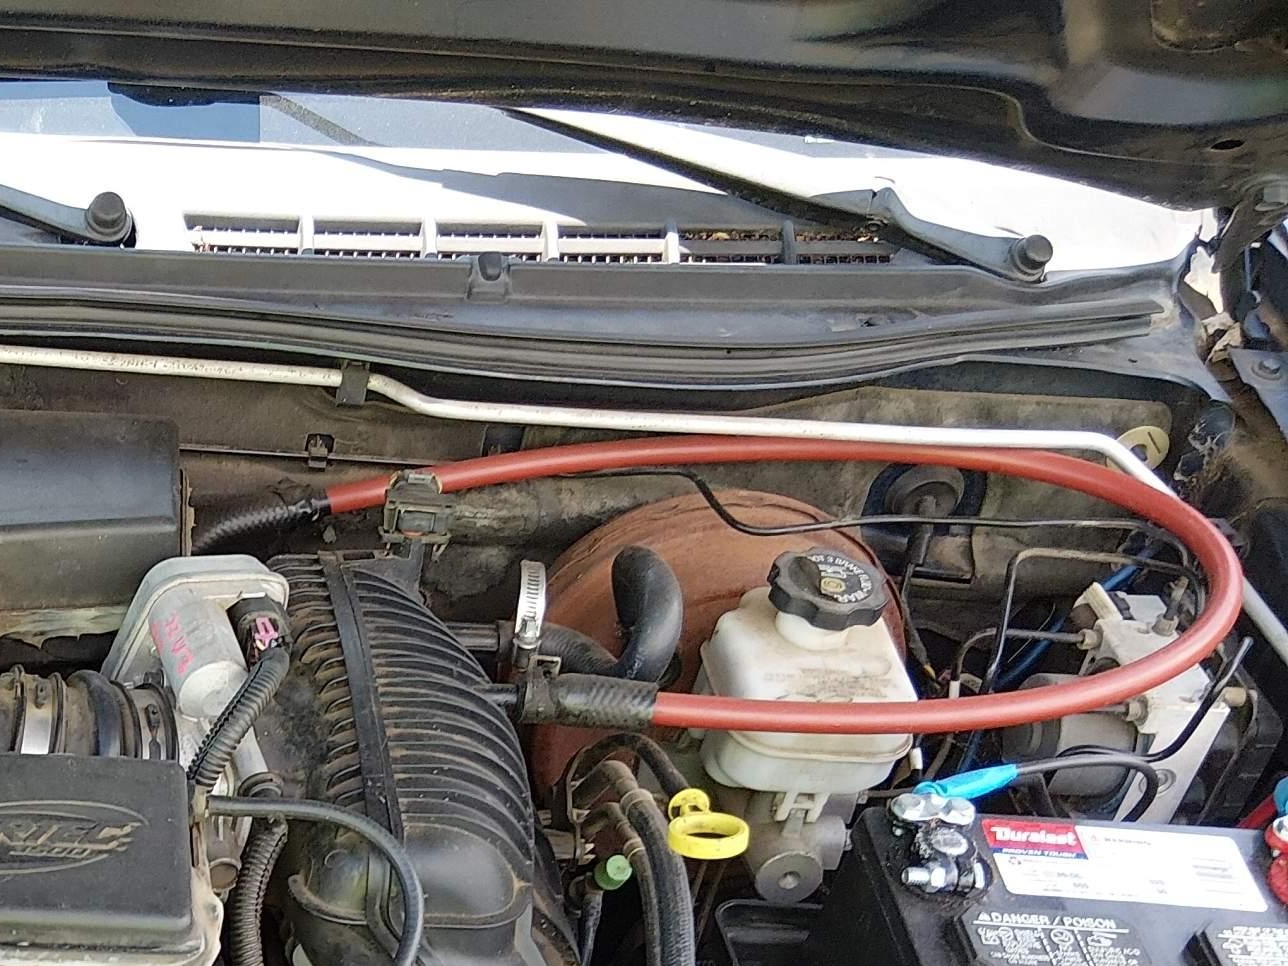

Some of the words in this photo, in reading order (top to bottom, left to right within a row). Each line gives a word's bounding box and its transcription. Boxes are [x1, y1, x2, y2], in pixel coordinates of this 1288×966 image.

[991, 826, 1078, 847] Duralast
[1001, 848, 1043, 857] PROVEN
[991, 912, 1049, 926] DANGER
[1063, 916, 1117, 929] POISON
